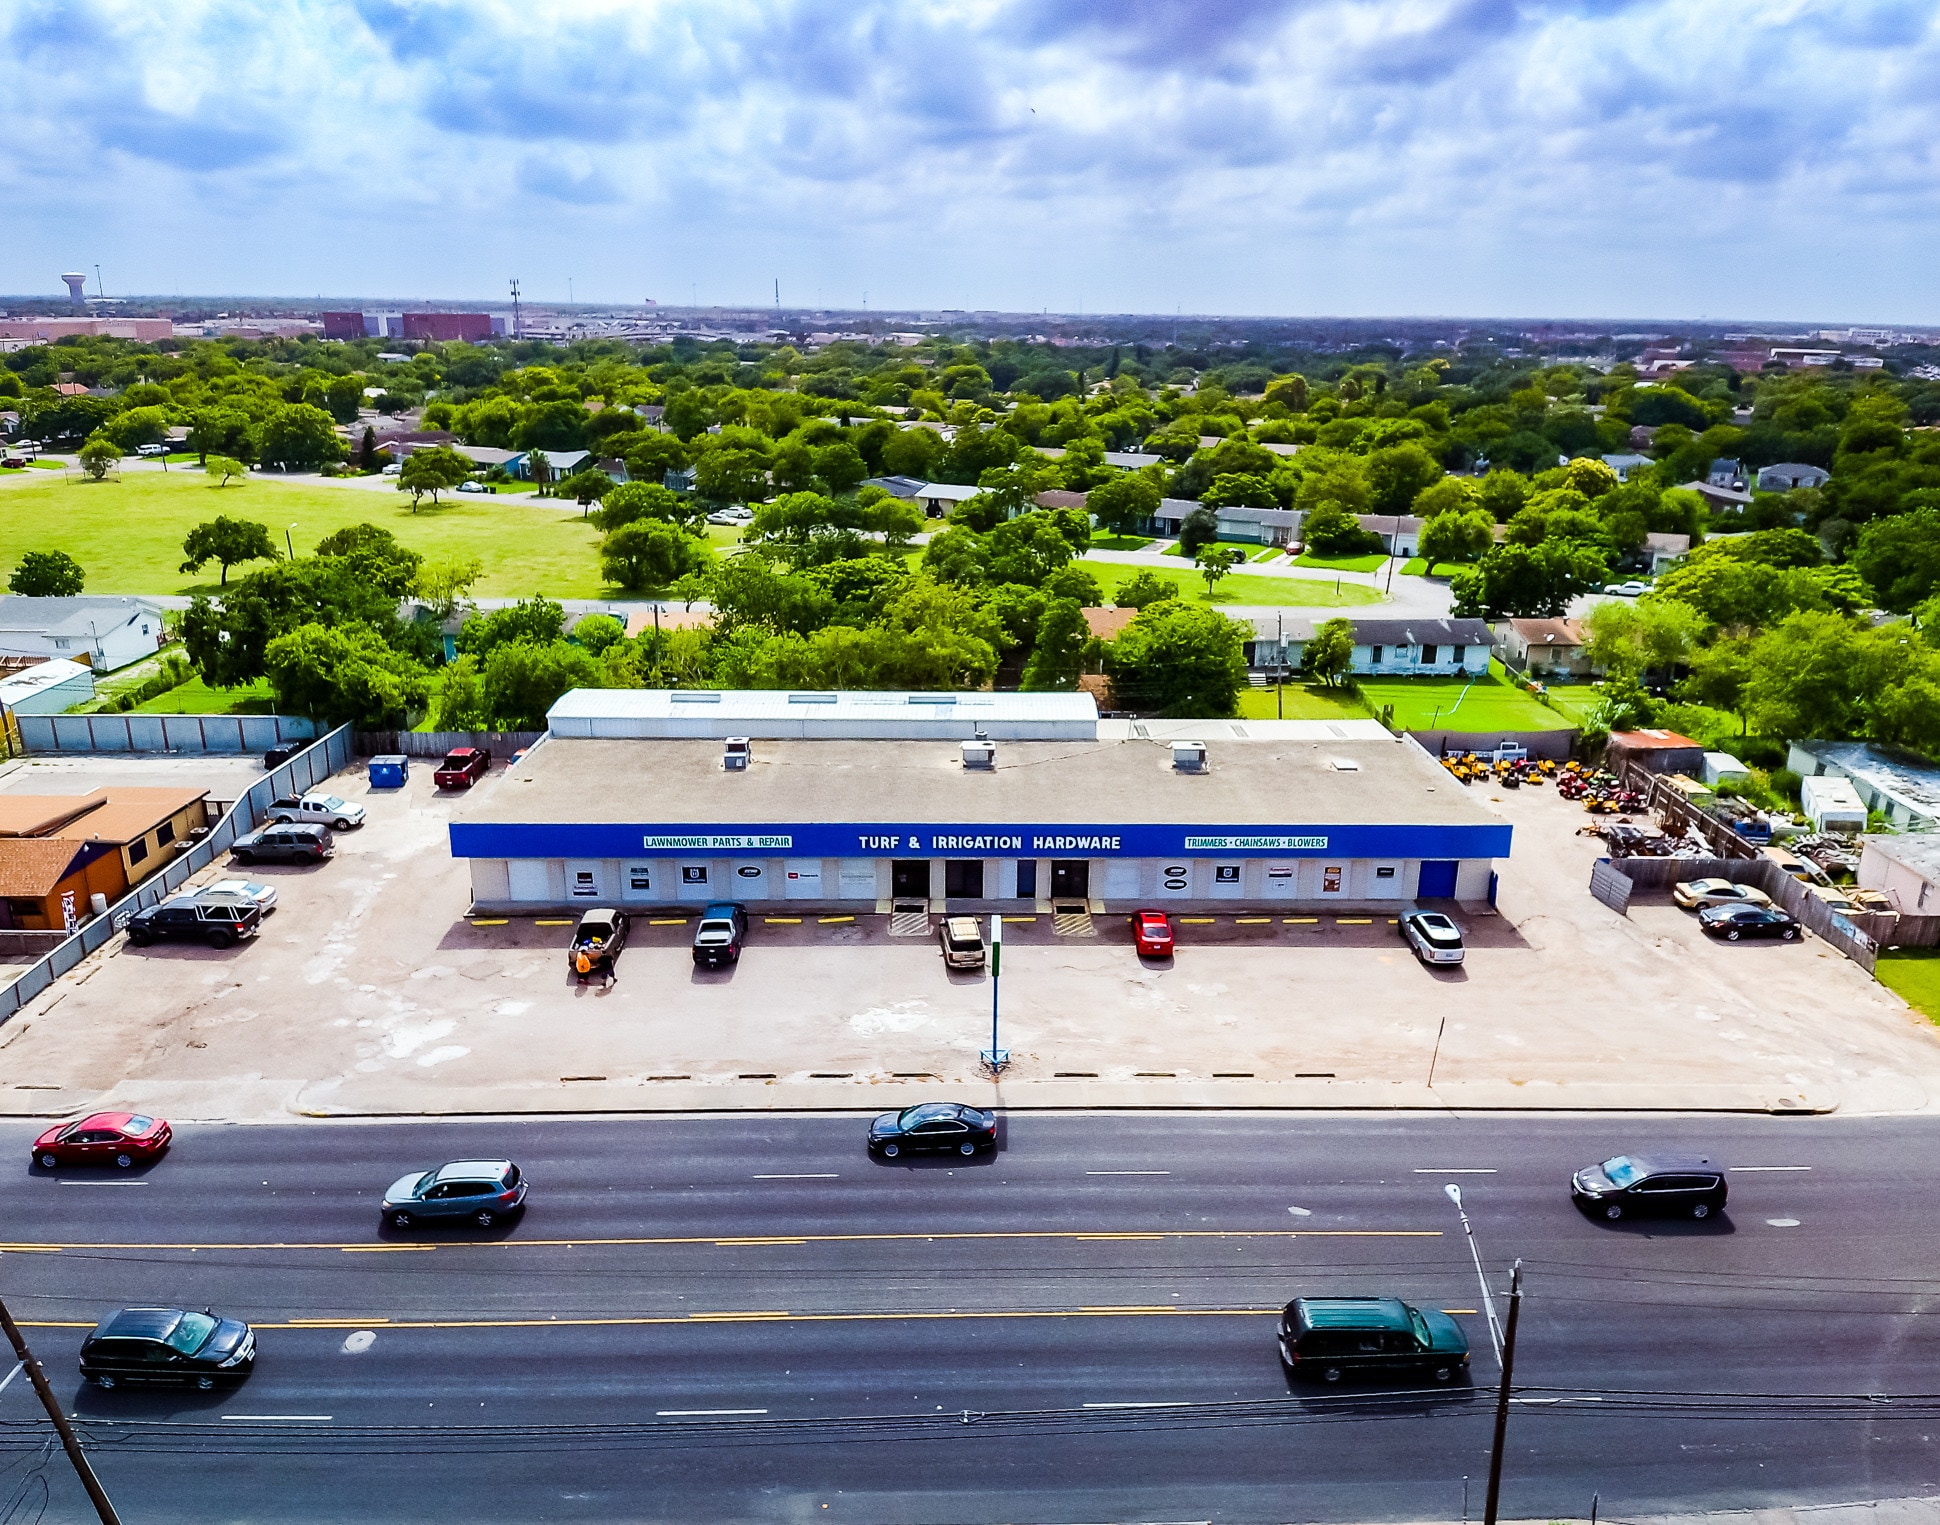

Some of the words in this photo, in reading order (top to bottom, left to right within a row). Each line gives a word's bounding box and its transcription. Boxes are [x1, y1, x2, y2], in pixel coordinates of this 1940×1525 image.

[645, 837, 708, 847] LAWNMOWER
[712, 837, 742, 847] PARTS
[746, 837, 754, 847] &
[759, 837, 790, 847] REPAIR
[859, 836, 899, 849] TURF
[908, 836, 920, 849] &
[932, 836, 1022, 849] IRRIGATION
[1033, 836, 1121, 849] HARDWARE
[1187, 838, 1228, 847] TRIMMERS
[1234, 838, 1281, 847] CHAINSAWS
[1287, 838, 1326, 847] BLOWERS
